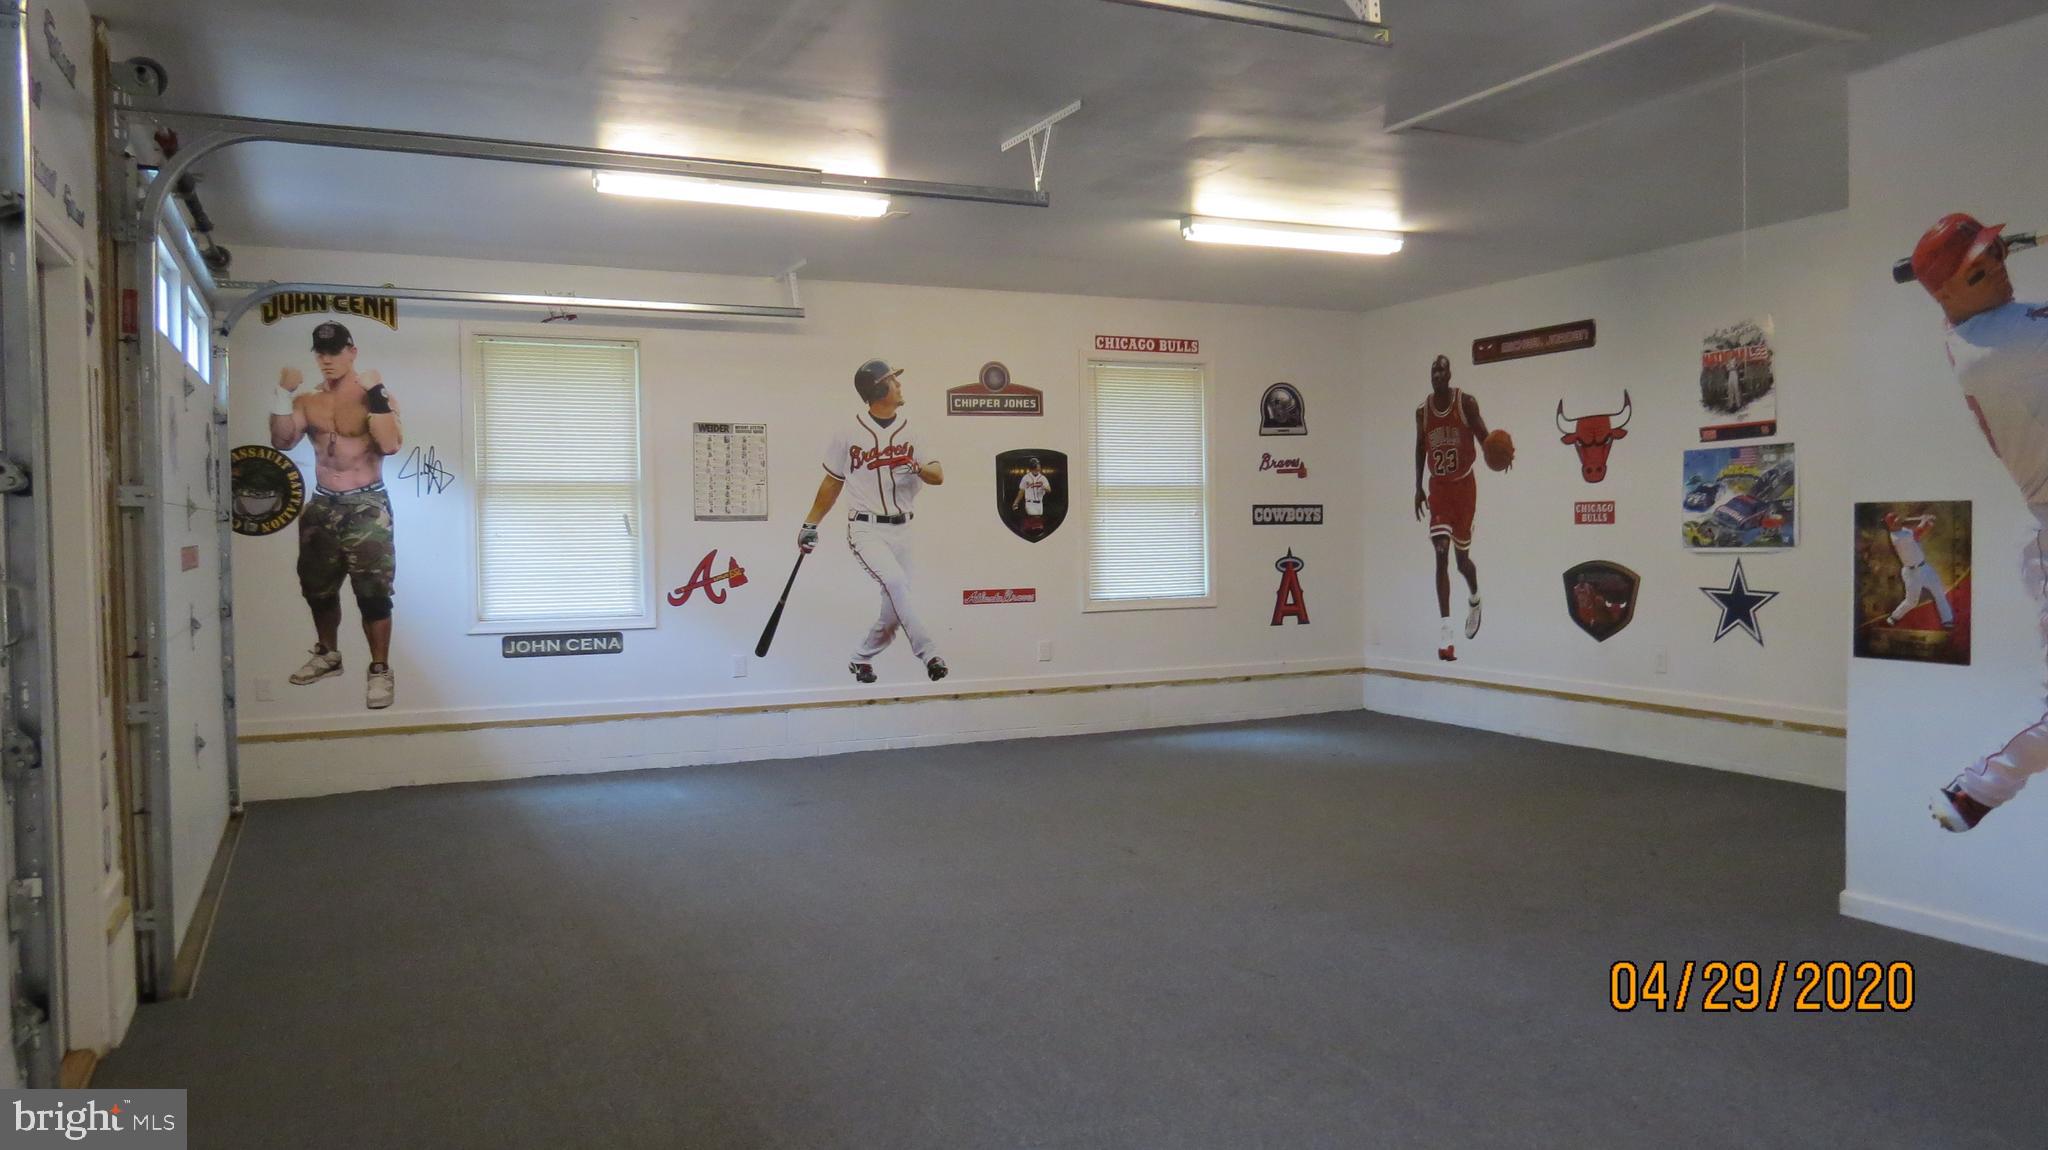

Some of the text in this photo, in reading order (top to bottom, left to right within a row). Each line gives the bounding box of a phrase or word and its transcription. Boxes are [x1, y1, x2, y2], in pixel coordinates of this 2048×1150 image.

[1096, 336, 1198, 353] CHICAGO BULLS
[954, 398, 1036, 408] CHIPPER JONES
[698, 423, 730, 433] WEIDER
[1433, 448, 1459, 475] 23
[1576, 503, 1614, 513] CHICAGO
[1254, 507, 1320, 522] COWBOYS
[1582, 513, 1607, 522] BULLS
[505, 637, 621, 654] JOHN CENA
